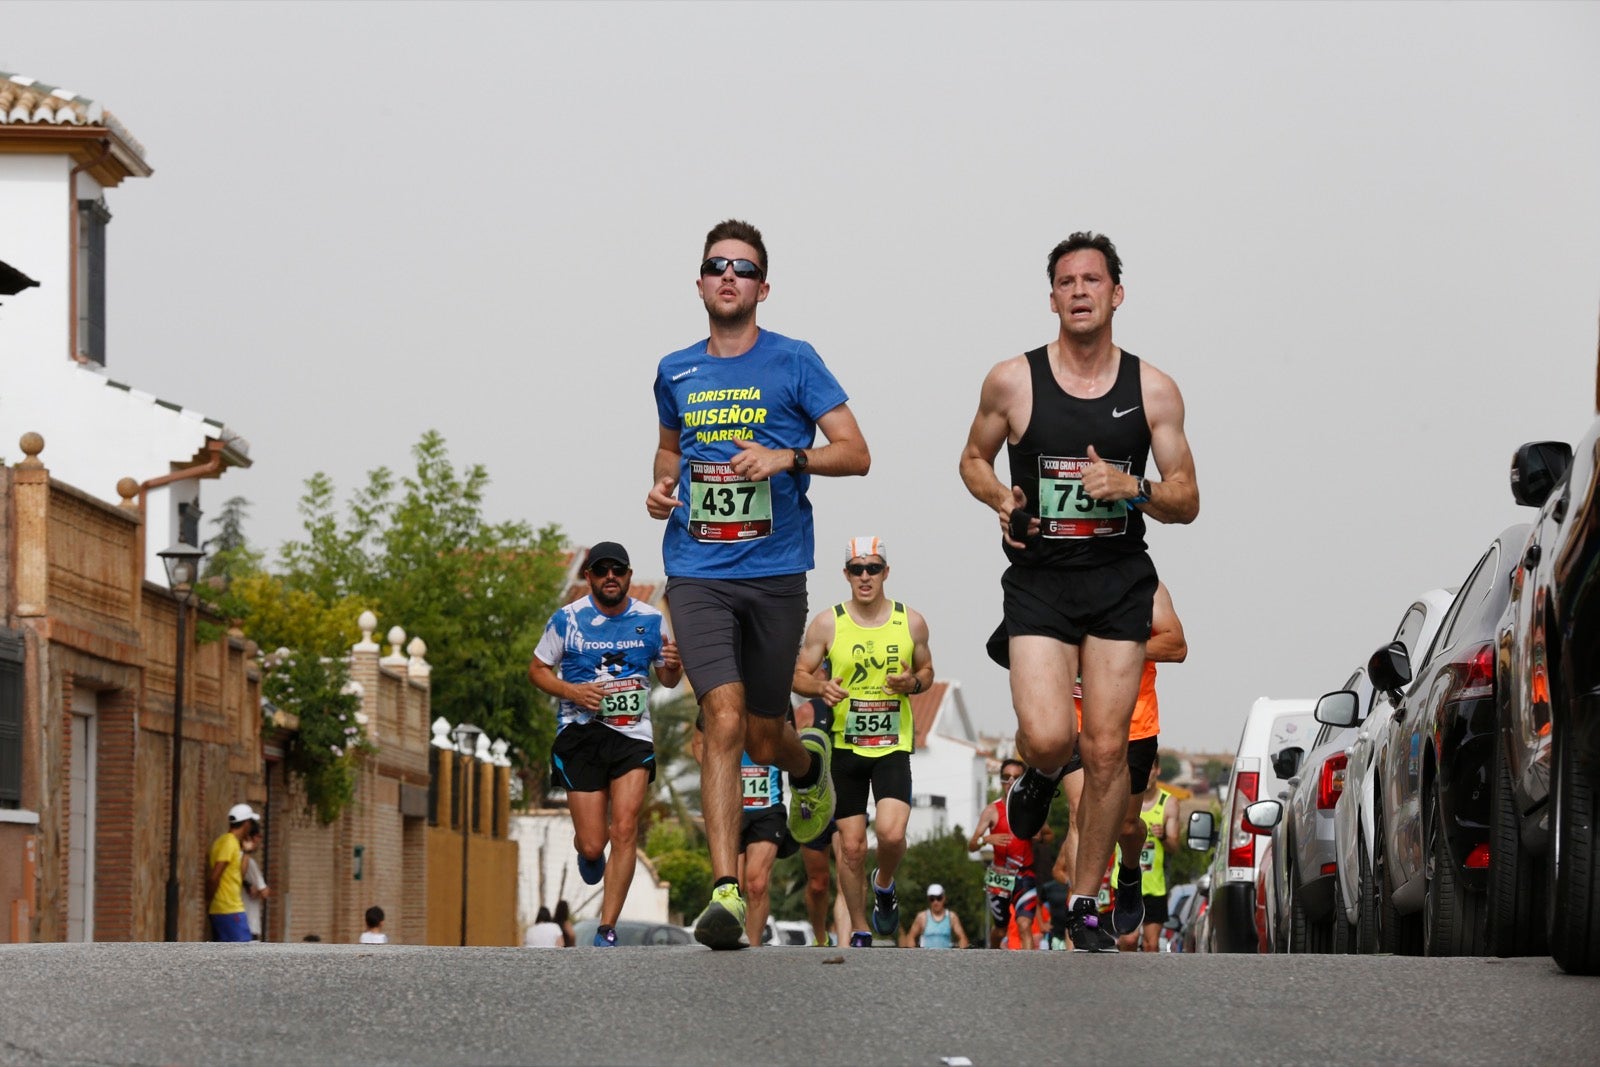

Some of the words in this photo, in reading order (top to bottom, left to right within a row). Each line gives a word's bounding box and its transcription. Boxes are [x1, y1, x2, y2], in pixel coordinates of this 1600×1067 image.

[688, 386, 760, 404] FLORISTERÍA
[684, 404, 767, 427] RUISEÑOR
[702, 487, 756, 516] 437
[586, 641, 613, 650] TODO
[617, 640, 645, 649] SUMA
[605, 693, 640, 712] 583
[855, 714, 892, 732] 554
